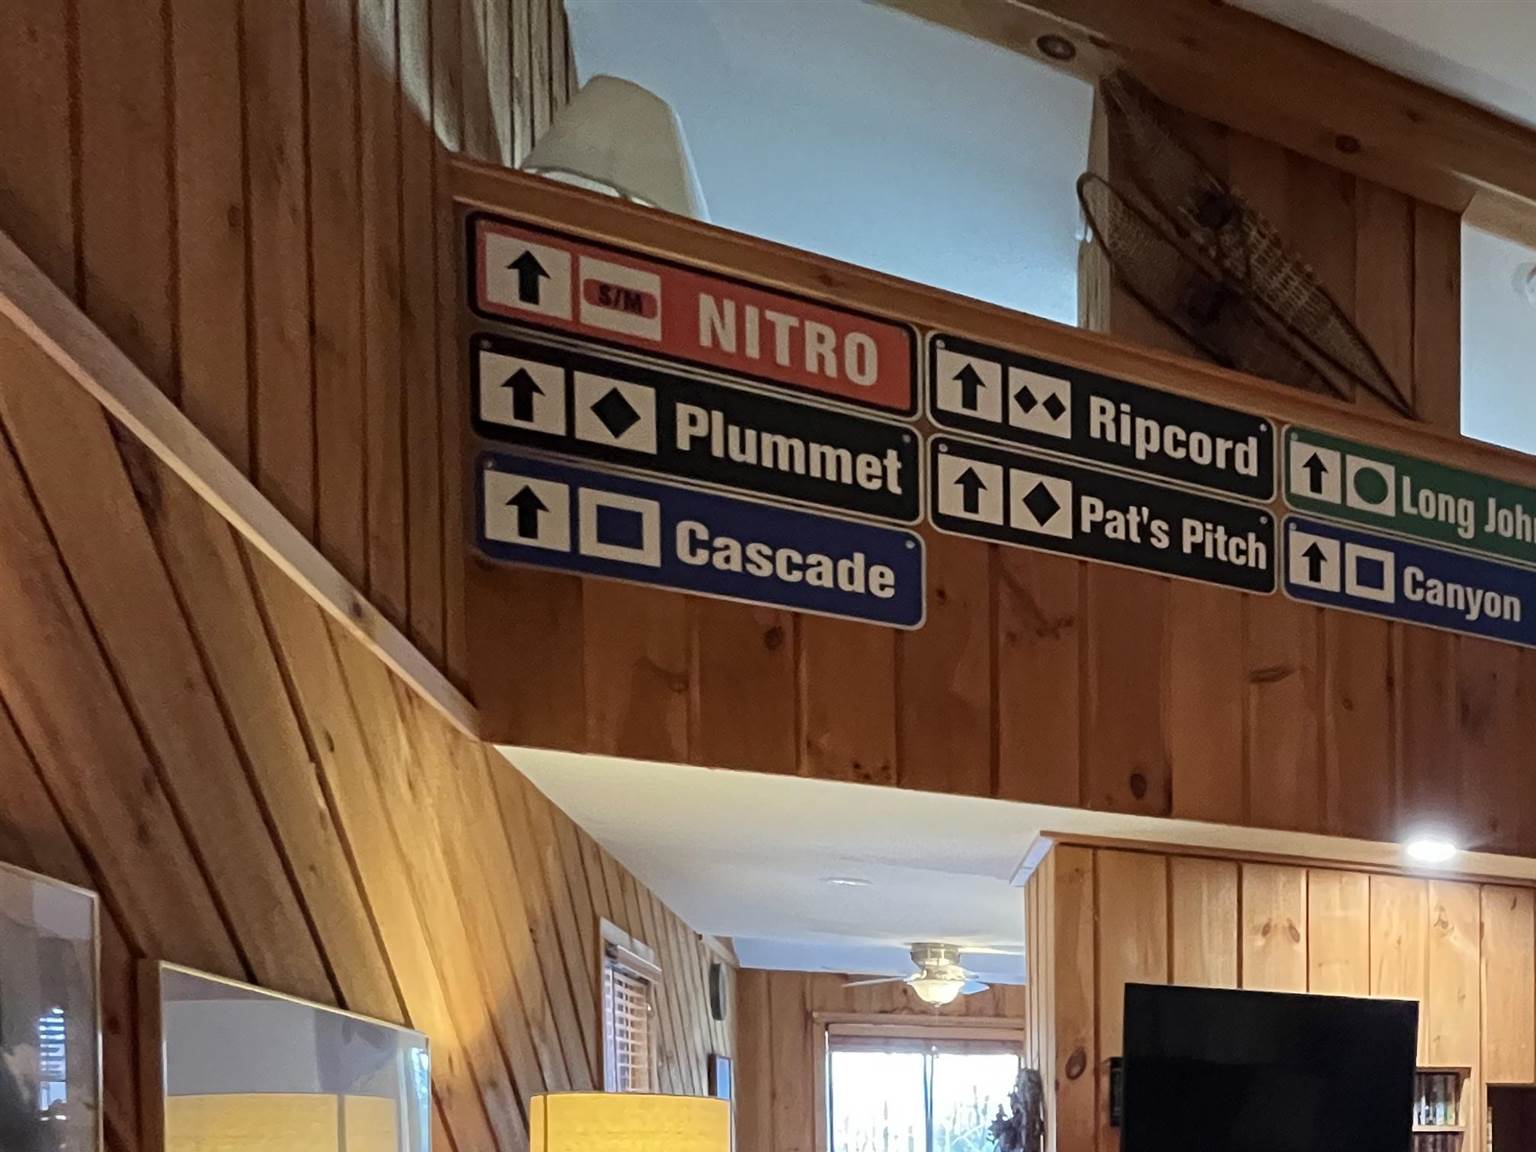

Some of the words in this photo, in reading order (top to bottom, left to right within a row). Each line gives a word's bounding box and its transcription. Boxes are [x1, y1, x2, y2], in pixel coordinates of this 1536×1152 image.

[699, 294, 878, 386] NITRO
[675, 402, 903, 495] Plummet
[1089, 395, 1258, 477] Ripcord
[1081, 495, 1170, 549] Pat's
[1182, 517, 1267, 570] Pitch
[1402, 475, 1474, 539] Long
[675, 520, 896, 598] Cascade
[1403, 565, 1521, 622] Canyon
